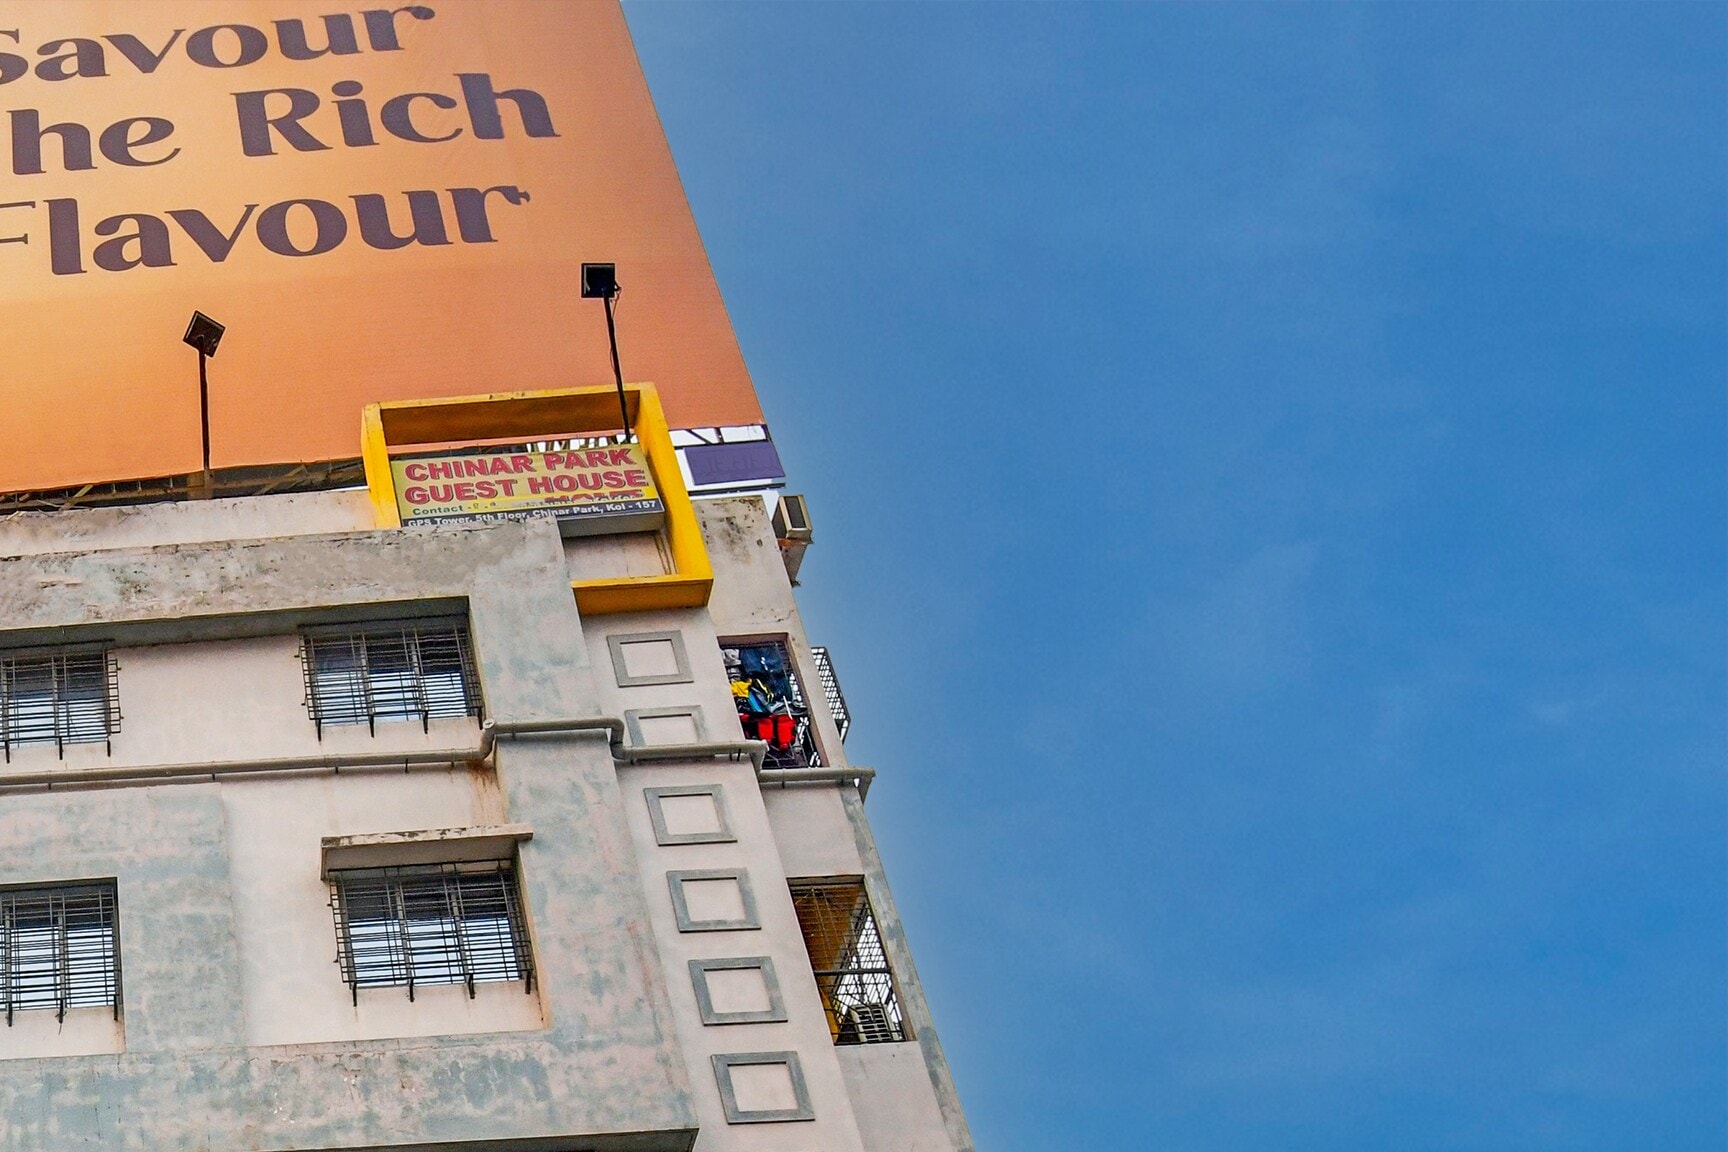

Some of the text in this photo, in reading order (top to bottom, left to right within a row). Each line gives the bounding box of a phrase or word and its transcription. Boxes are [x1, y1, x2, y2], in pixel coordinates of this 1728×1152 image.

[230, 73, 561, 157] Rich
[405, 448, 637, 481] CHINAR PARK
[405, 479, 517, 504] GUEST
[527, 470, 649, 494] HOUSE
[408, 519, 433, 527] GPS
[476, 513, 494, 521] 5th
[532, 507, 569, 519] Chinar
[573, 505, 604, 514] Park,
[606, 502, 626, 511] Kol
[636, 500, 656, 509] 157
[413, 505, 463, 515] Contact
